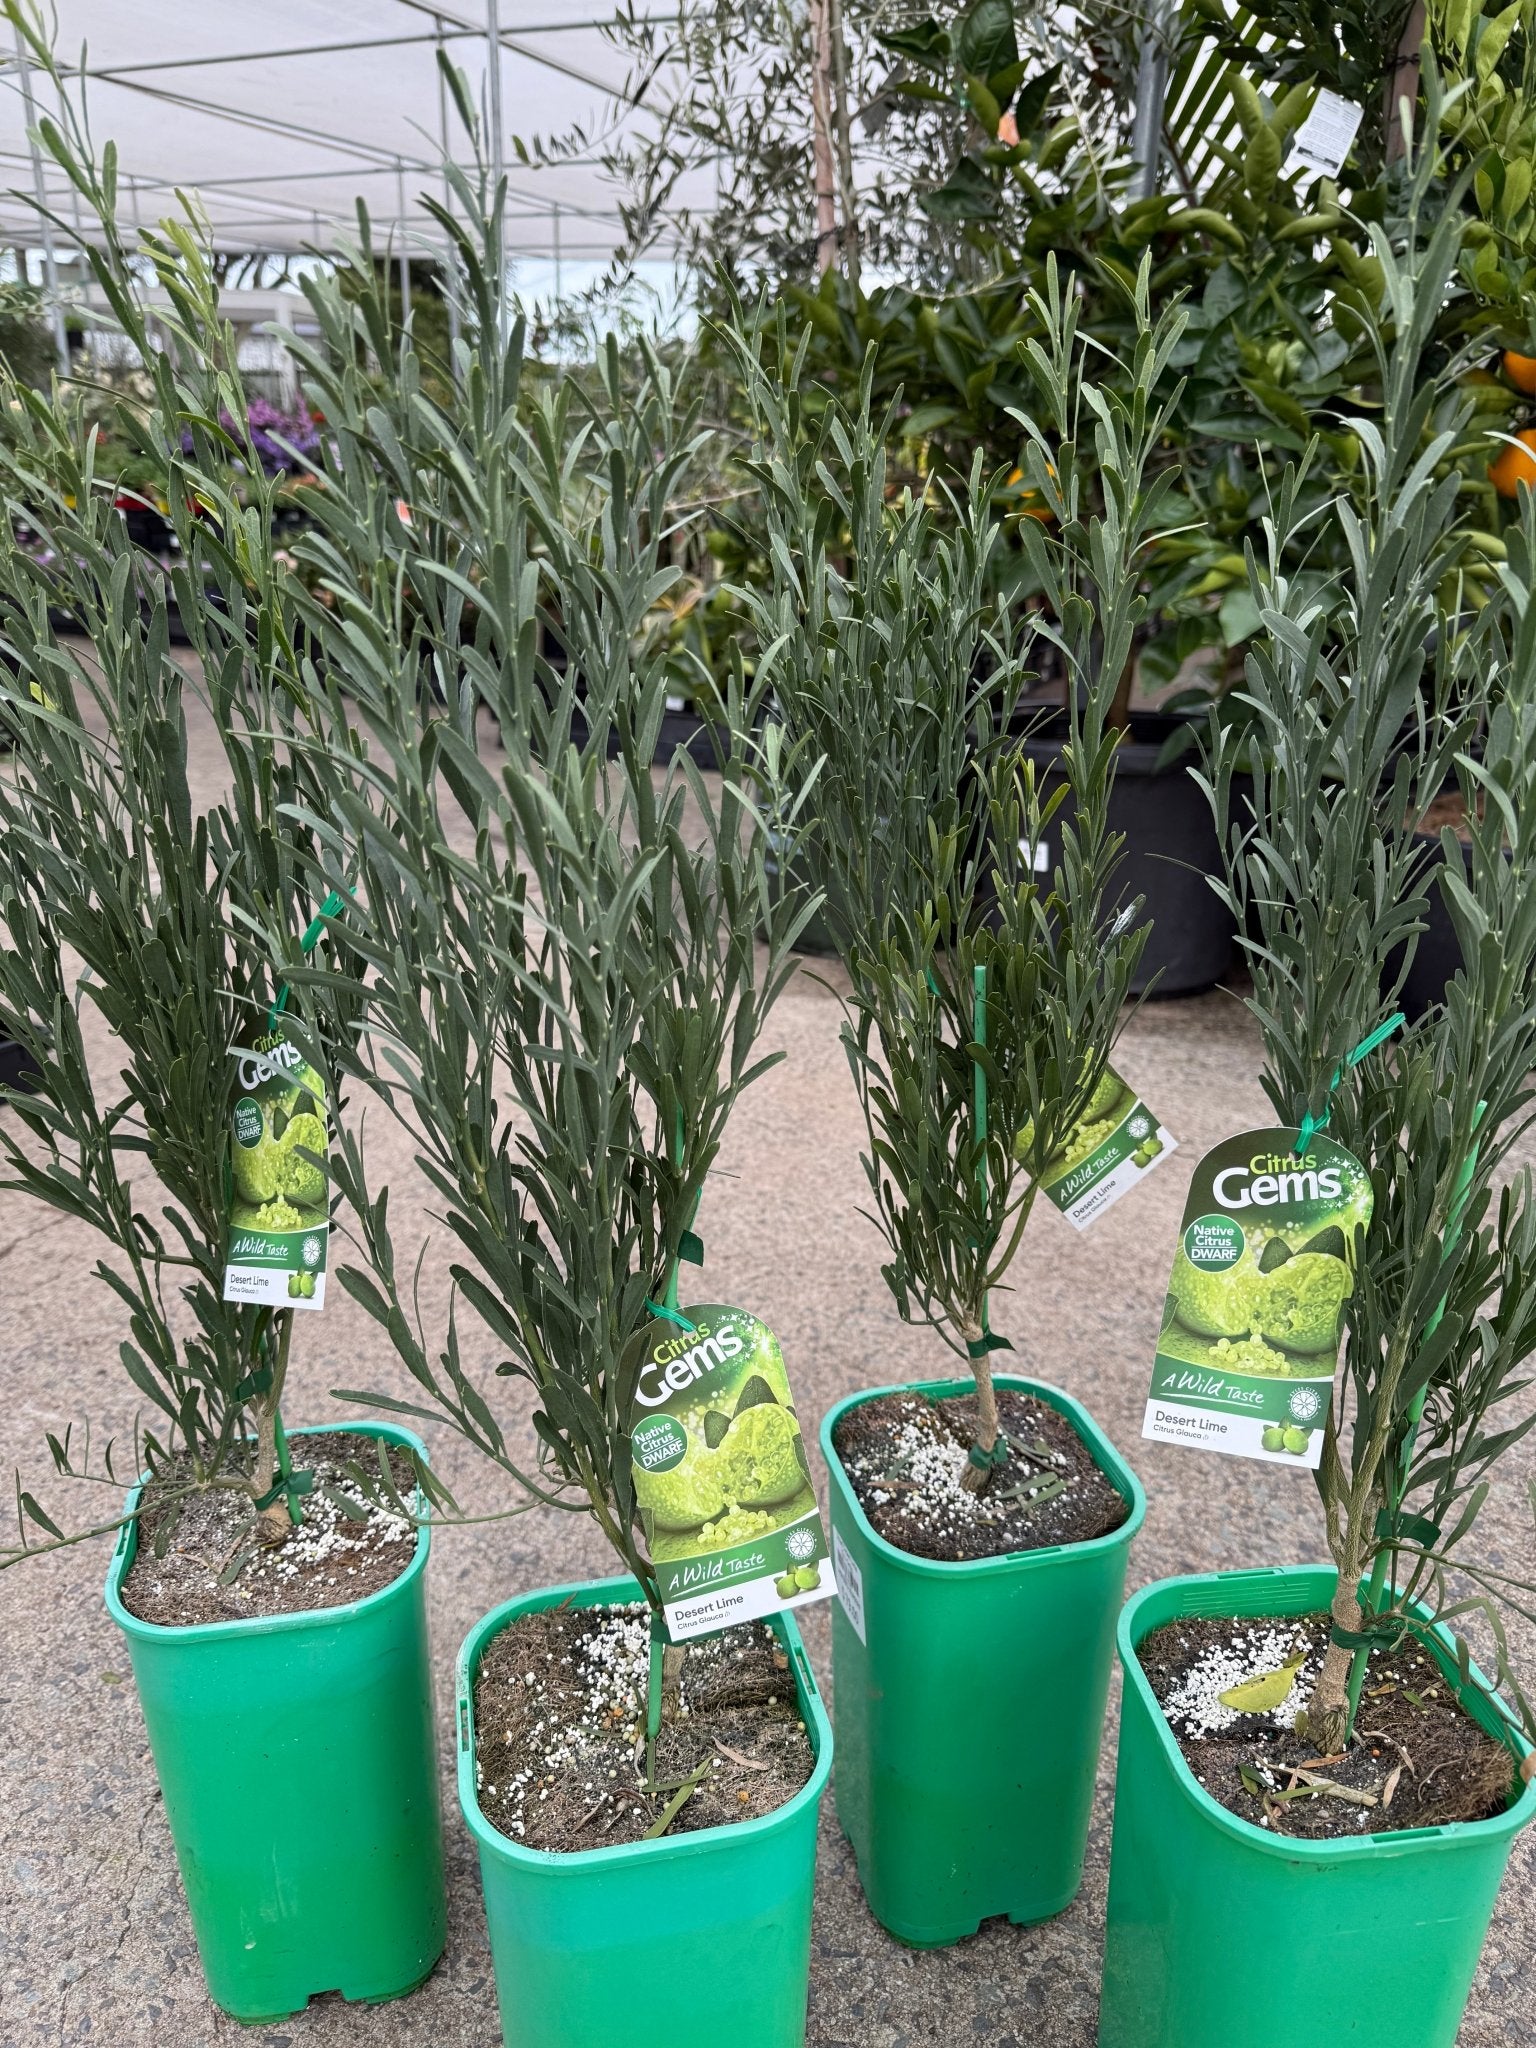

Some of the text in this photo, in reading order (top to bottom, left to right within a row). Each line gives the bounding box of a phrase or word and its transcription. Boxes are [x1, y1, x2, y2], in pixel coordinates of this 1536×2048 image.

[253, 1030, 285, 1053] Citrus
[239, 1040, 302, 1090] Gems
[236, 1107, 257, 1118] Native
[239, 1116, 257, 1127] Citrus
[238, 1125, 261, 1139] DWARF
[1061, 1147, 1119, 1202] A Wild Taste
[1249, 1153, 1317, 1174] Citrus
[1072, 1180, 1116, 1218] Desert Lime
[1212, 1167, 1342, 1209] Gems
[1193, 1225, 1235, 1236] Native
[1195, 1235, 1232, 1246] Citrus
[233, 1240, 241, 1253] A
[240, 1236, 266, 1255] Wild
[266, 1244, 289, 1256] Taste
[1191, 1248, 1237, 1259] DWARF
[230, 1274, 269, 1286] Desert Lime
[653, 1323, 711, 1364] Citrus
[634, 1325, 743, 1407] Gems
[1161, 1371, 1265, 1403] A Wild Taste
[1153, 1424, 1202, 1439] Citrus Glauca
[1155, 1410, 1228, 1434] Desert Lime
[634, 1423, 671, 1445] Native
[641, 1433, 674, 1452] Citrus
[642, 1440, 683, 1467] DWARF
[669, 1553, 766, 1591] A Wild Taste
[675, 1595, 744, 1621] Desert Lime
[677, 1613, 724, 1630] Citrus Glauca
